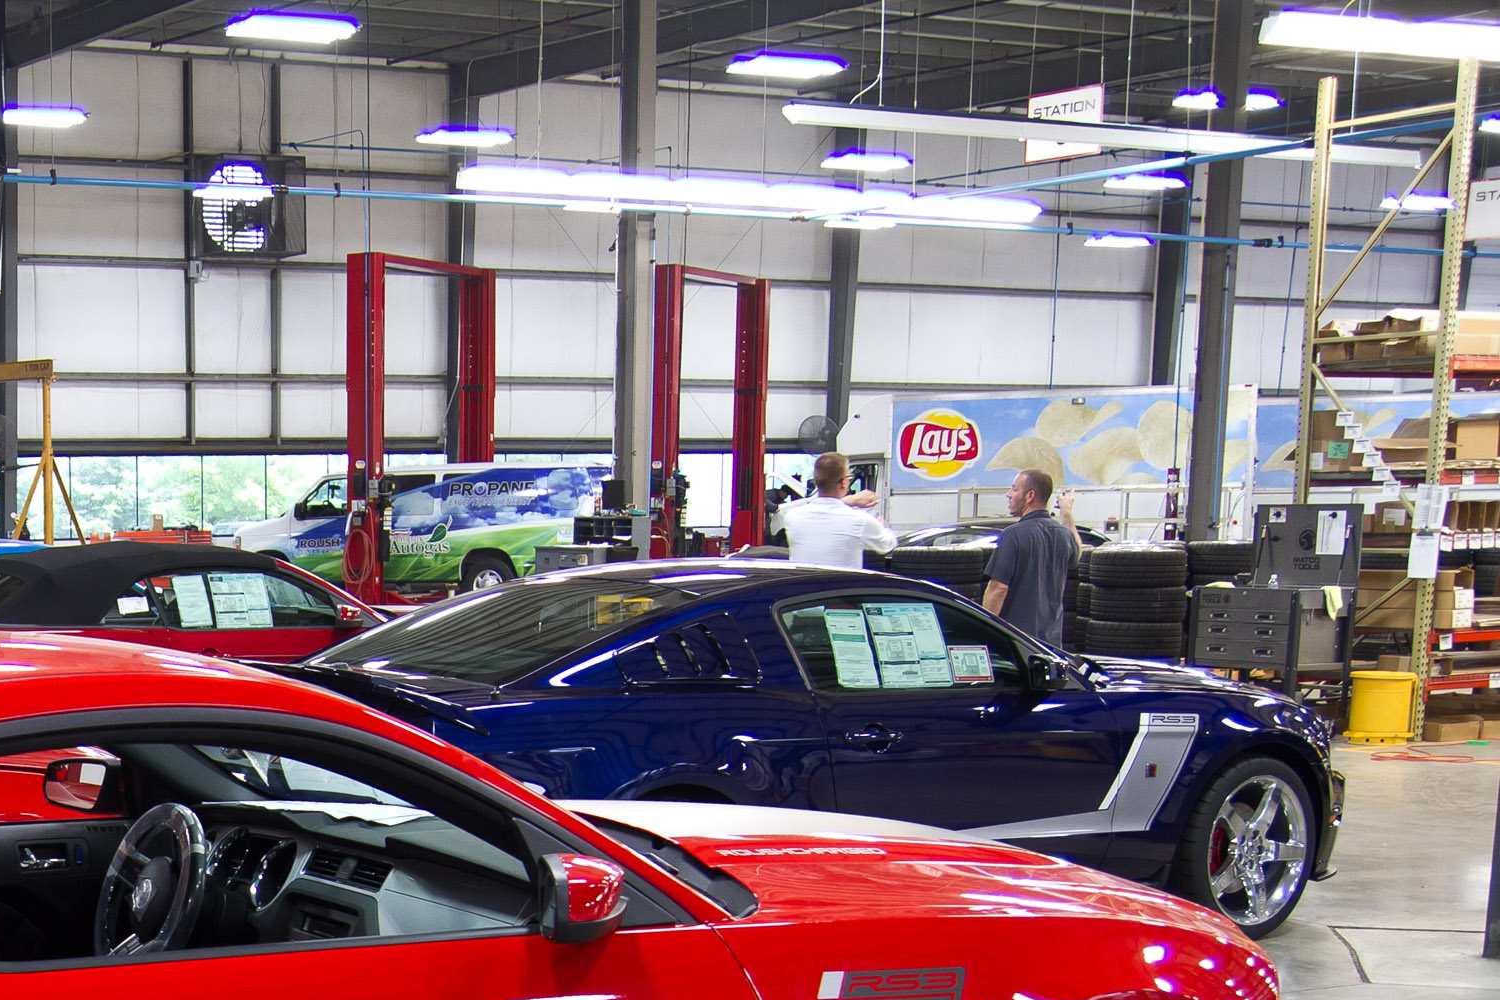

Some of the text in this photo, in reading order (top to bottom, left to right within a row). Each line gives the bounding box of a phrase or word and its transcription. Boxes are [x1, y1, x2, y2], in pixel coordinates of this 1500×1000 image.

[1033, 98, 1097, 119] STATION
[906, 424, 972, 465] Lay's
[300, 538, 340, 548] ROUSH
[390, 540, 450, 557] Autogas
[1152, 715, 1196, 723] RS3
[848, 972, 957, 993] RS3
